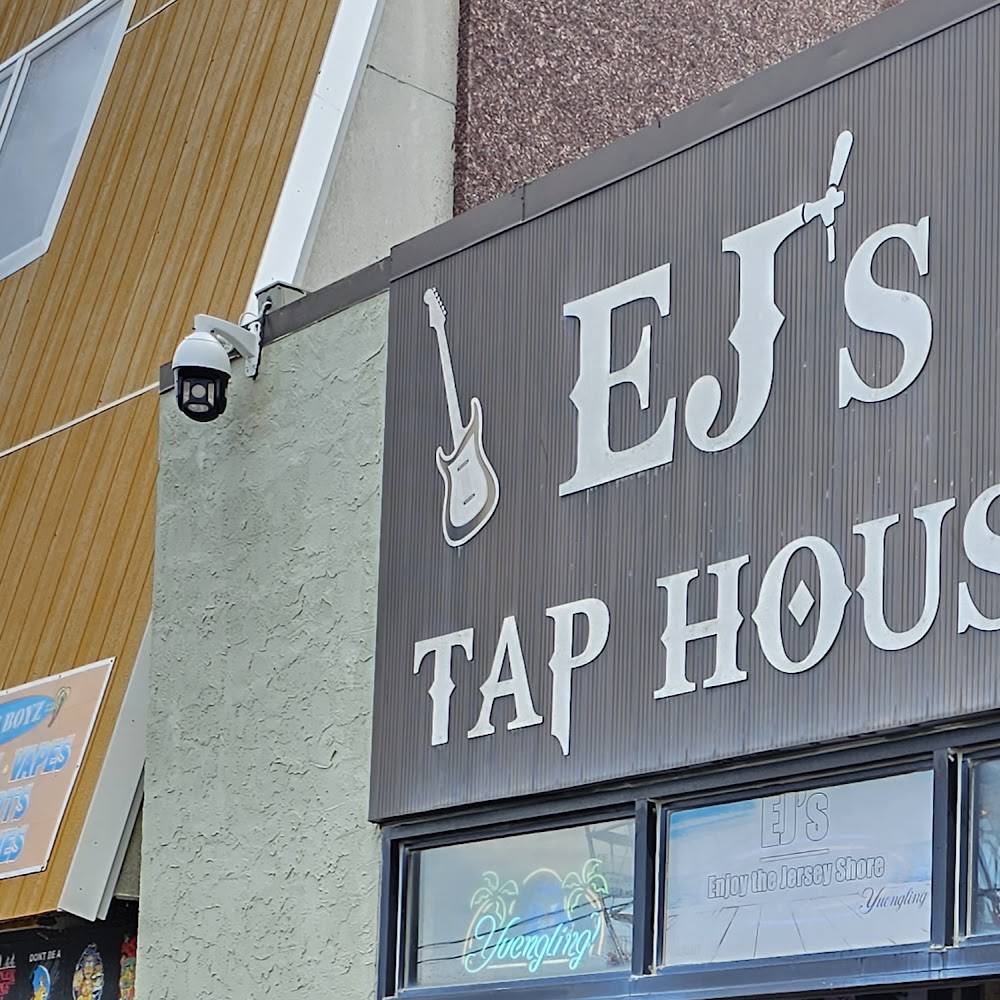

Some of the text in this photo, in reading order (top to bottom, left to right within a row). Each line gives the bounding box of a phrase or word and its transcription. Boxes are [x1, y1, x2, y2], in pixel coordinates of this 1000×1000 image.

[413, 598, 611, 756] TAP
[3, 700, 45, 734] BOYZ
[707, 856, 886, 900] Enjoy the Jersey Shore
[858, 887, 928, 914] Yuengling
